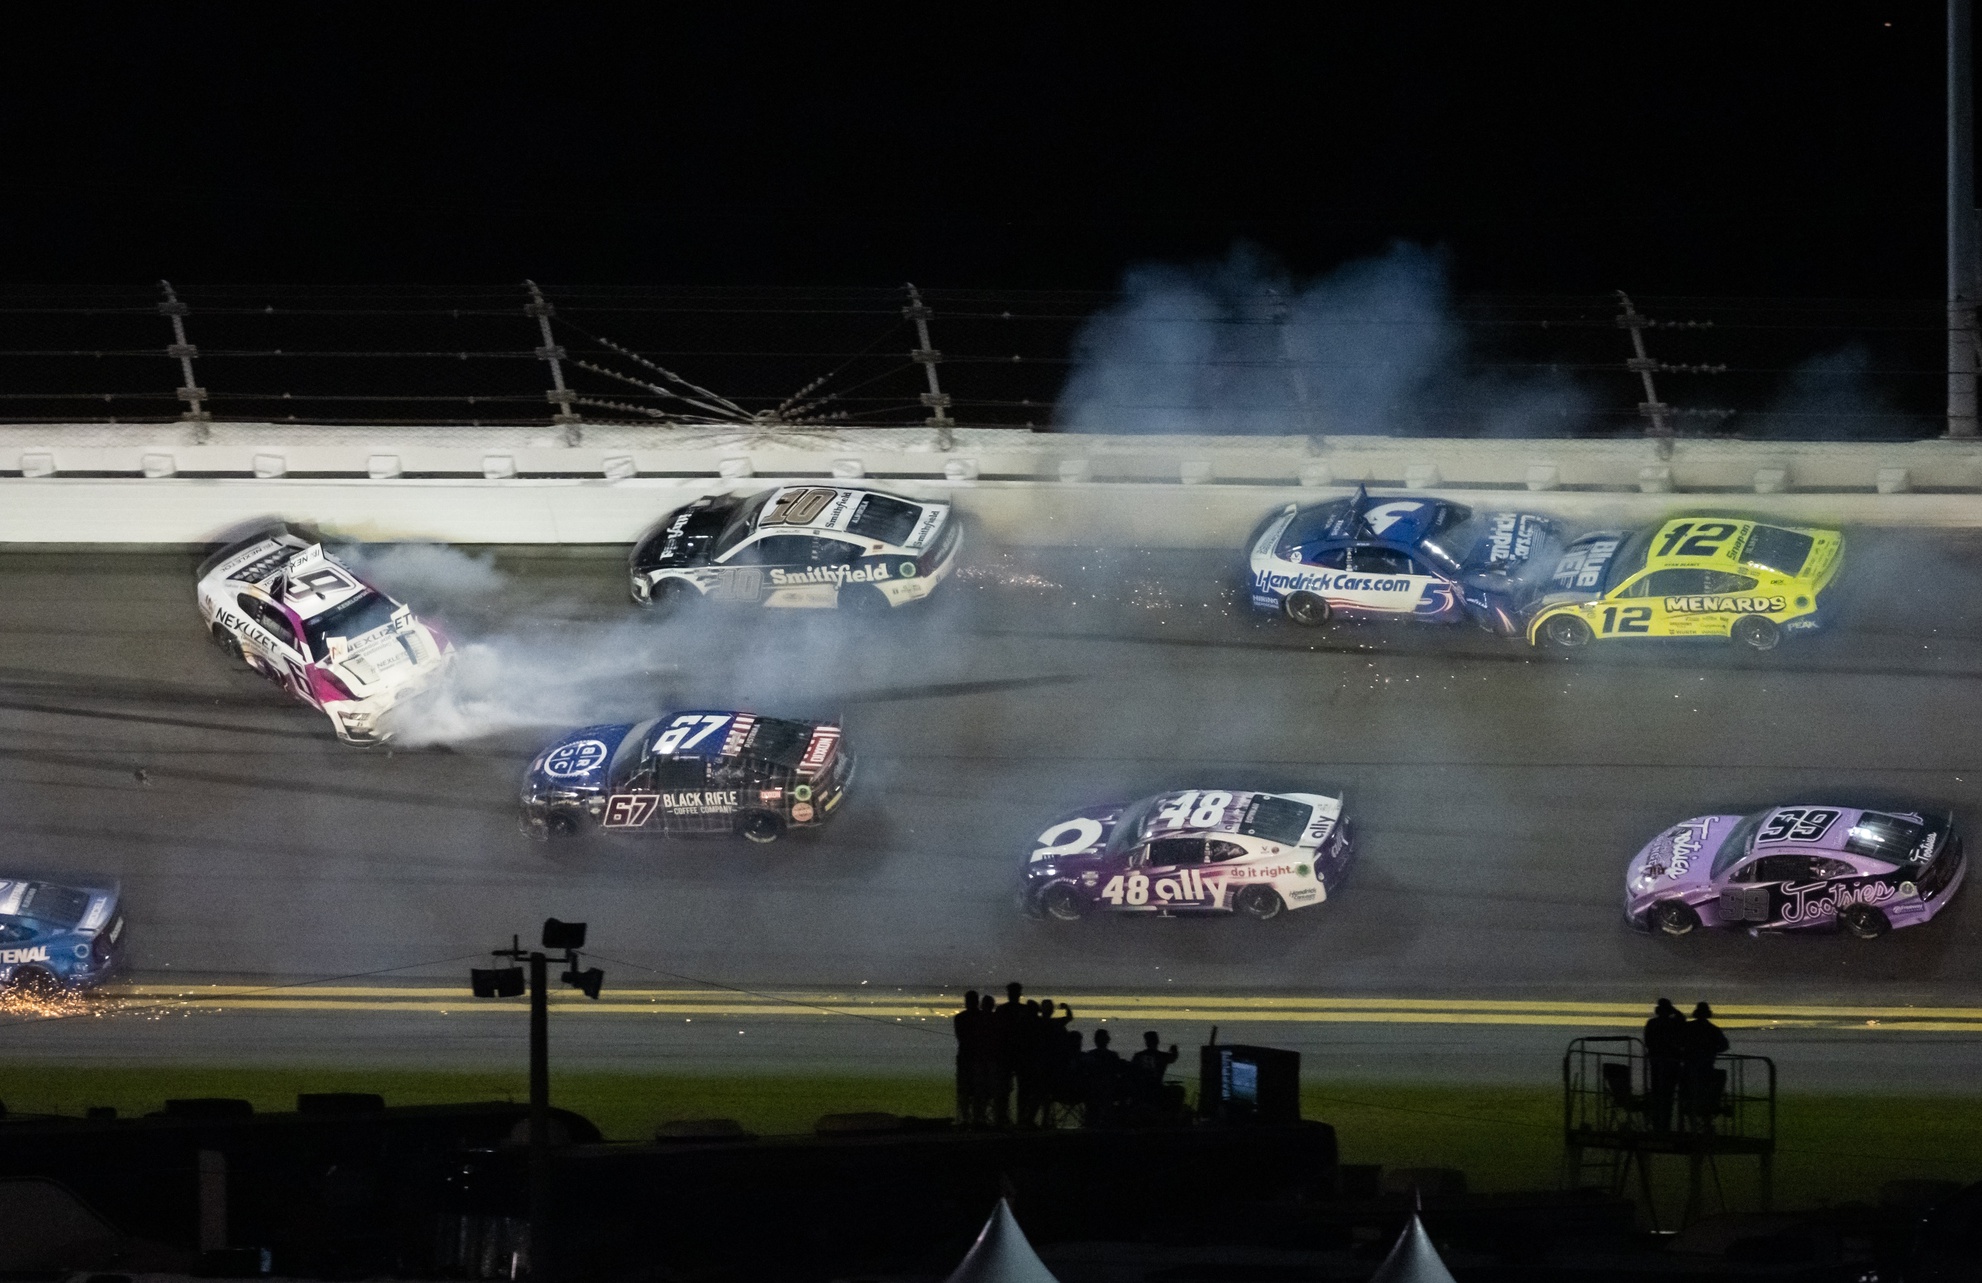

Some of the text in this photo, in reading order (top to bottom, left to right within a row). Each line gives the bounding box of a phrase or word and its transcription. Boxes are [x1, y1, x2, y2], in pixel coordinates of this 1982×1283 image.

[759, 489, 838, 526] 10
[825, 492, 852, 528] Smithfield
[912, 511, 940, 547] Smithfield
[1656, 523, 1738, 557] 12
[1726, 523, 1751, 560] Snap-on
[718, 567, 765, 602] 10
[770, 564, 891, 591] Smithfield
[1412, 582, 1455, 615] 5
[1665, 595, 1787, 614] MENARDS
[216, 607, 278, 652] NEXLIZET
[1602, 607, 1653, 633] 12
[1787, 618, 1819, 631] PEAK
[651, 715, 732, 755] 67
[603, 794, 660, 827] 67
[662, 790, 738, 808] BLACK RIFLE
[673, 804, 733, 815] COFFEE COMPANY
[1159, 792, 1233, 829] 48
[1309, 815, 1336, 839] ally
[1758, 808, 1841, 843] 99
[1230, 865, 1295, 878] do it right.
[1102, 875, 1150, 906] 48
[1155, 869, 1228, 909] ally
[1719, 887, 1770, 922] 99
[1780, 880, 1896, 923] Tootsies
